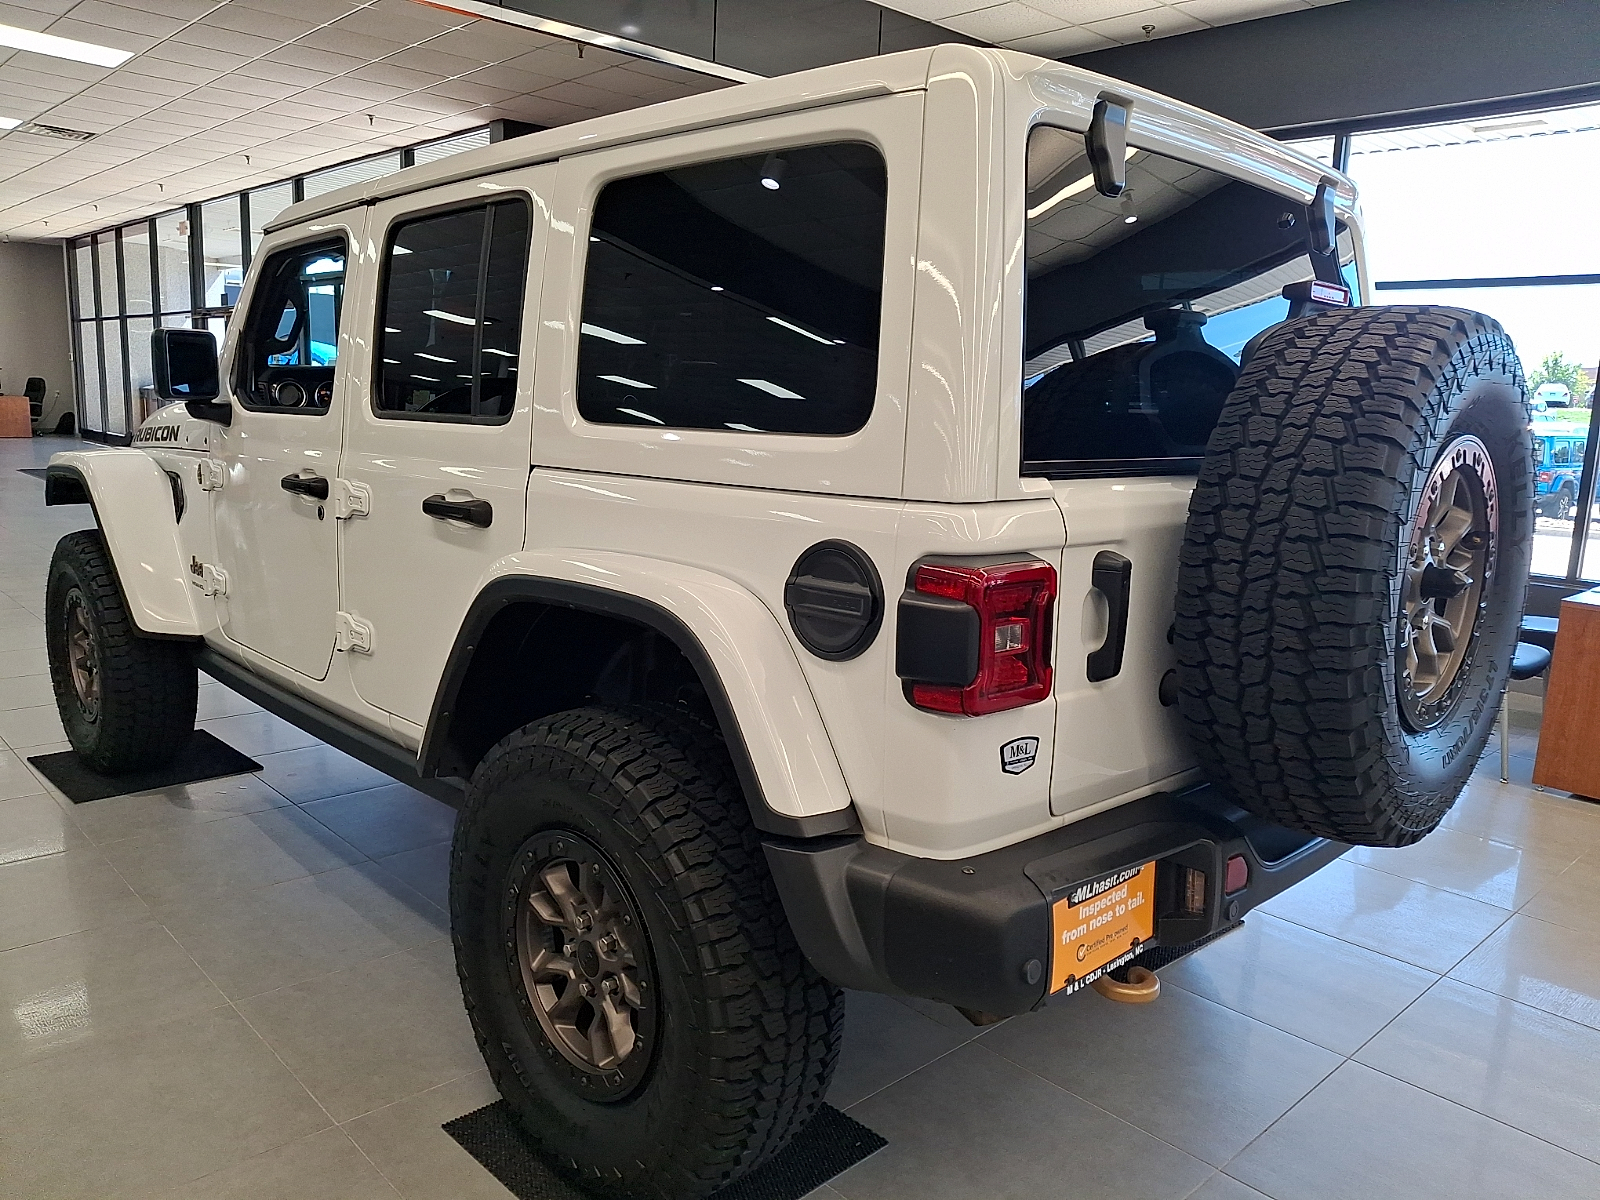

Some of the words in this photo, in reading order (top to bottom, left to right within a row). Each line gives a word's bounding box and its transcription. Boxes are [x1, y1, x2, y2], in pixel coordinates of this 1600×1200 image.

[132, 424, 181, 442] RUBICON
[1009, 743, 1032, 759] M&L
[1079, 884, 1128, 920] Inspected
[1061, 923, 1087, 945] from
[1089, 911, 1113, 931] nose
[1115, 904, 1125, 917] to
[1127, 891, 1145, 911] tail.
[1080, 979, 1085, 988] L
